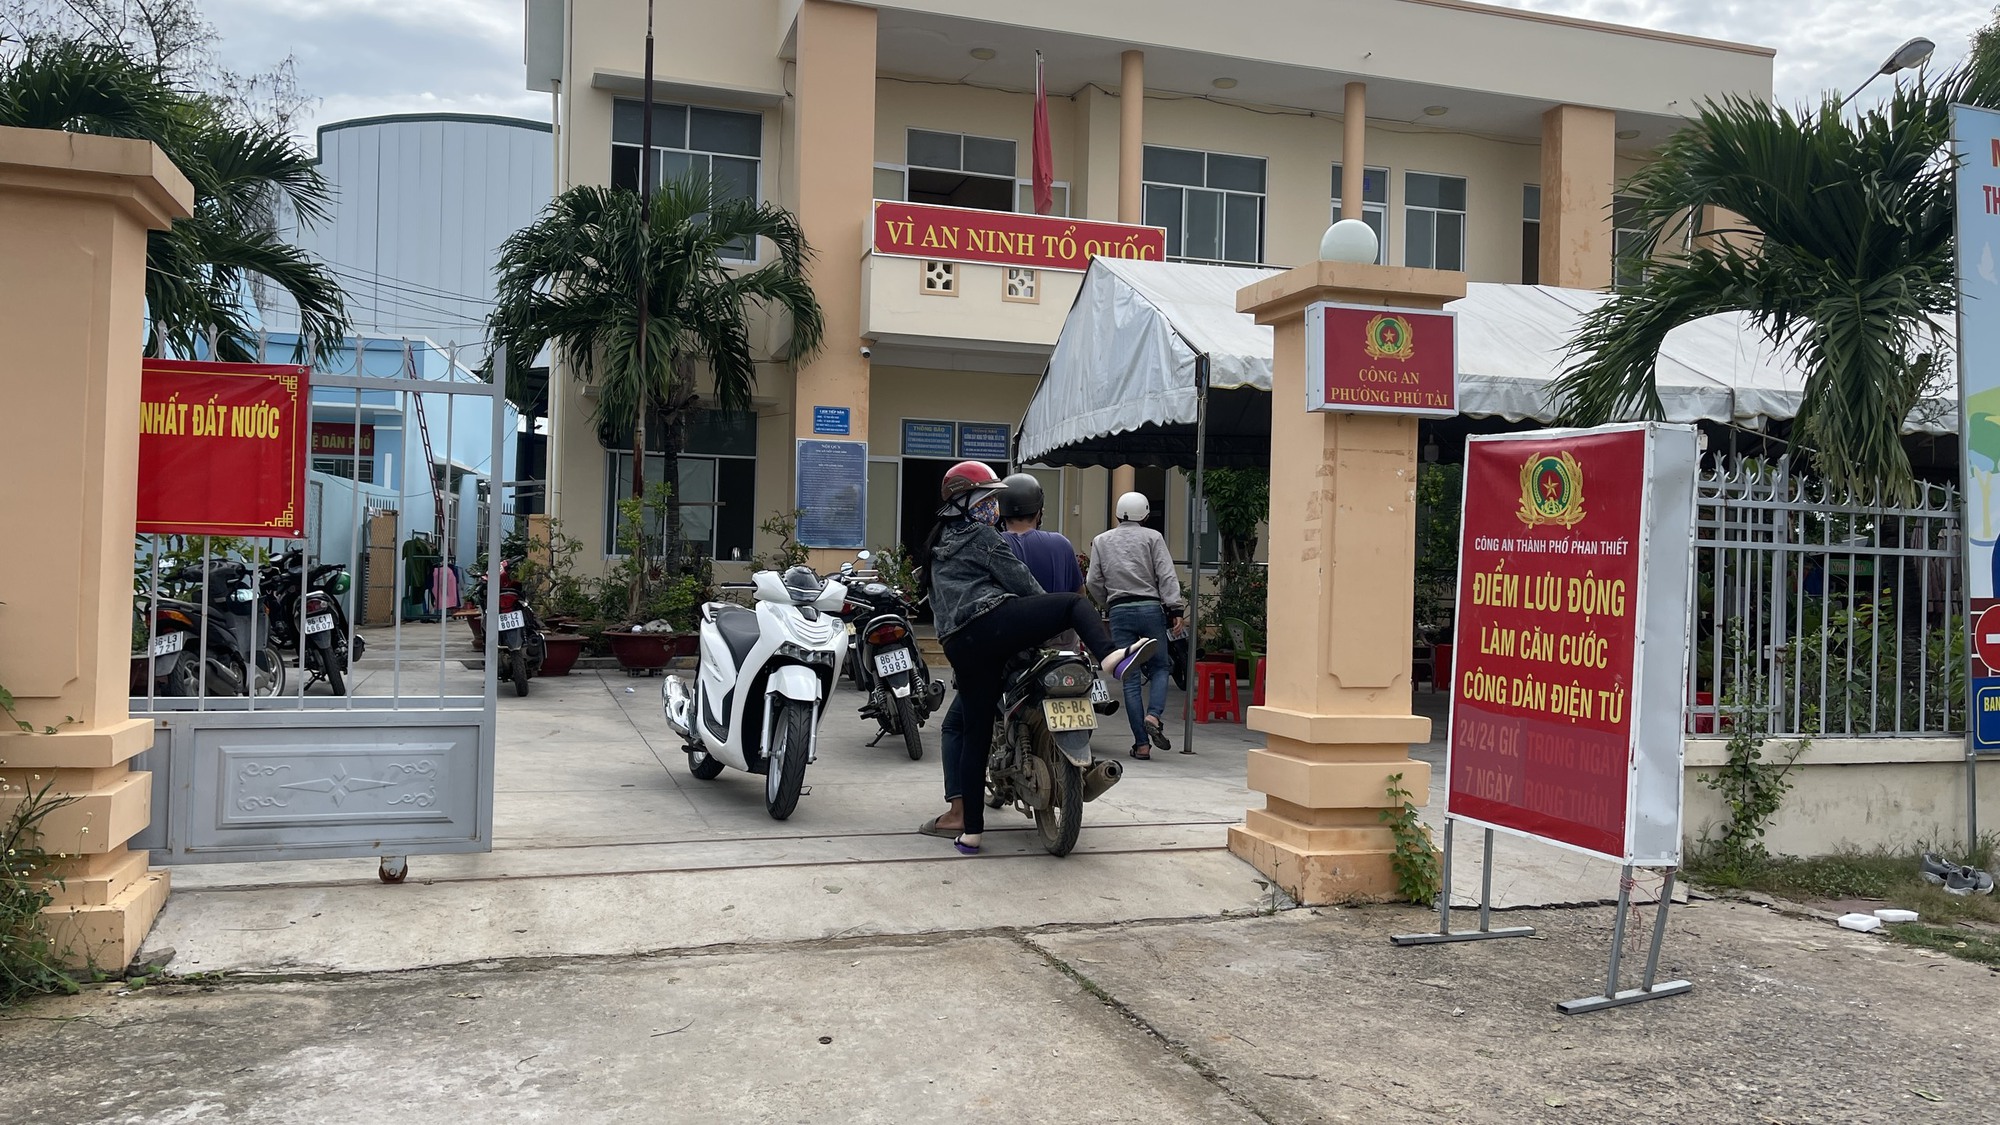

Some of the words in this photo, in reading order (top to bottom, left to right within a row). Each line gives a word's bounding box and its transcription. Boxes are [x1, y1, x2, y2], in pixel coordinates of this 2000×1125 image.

[885, 215, 915, 246] VÌ
[921, 224, 960, 250] AN
[966, 228, 1036, 257] NINH
[1042, 225, 1077, 260] TỔ
[1359, 365, 1398, 384] CÔNG
[1400, 371, 1420, 385] AN
[1331, 385, 1390, 403] PHƯỜNG
[1394, 388, 1422, 405] PHÚ
[1425, 389, 1449, 407] TÀI
[140, 391, 188, 436] NHẤT
[192, 393, 227, 437] ĐẤT
[231, 399, 280, 440] NƯỚC
[321, 433, 346, 449] DÂN
[348, 432, 371, 450] PỐ
[1475, 535, 1500, 552] CÔNG
[1501, 538, 1514, 552] AN
[1516, 536, 1546, 553] THÀNH
[1549, 535, 1570, 554] PHỐ
[1571, 540, 1598, 555] PHAN
[1600, 536, 1629, 556] THIẾT
[1472, 557, 1519, 609] ĐIỂM
[1523, 571, 1562, 612] LƯU
[1567, 569, 1626, 622] ĐỘNG
[880, 650, 905, 665] 86-L3
[1481, 621, 1516, 657] LÀM
[1520, 625, 1555, 662] CĂN
[1559, 630, 1609, 669] CƯỚC
[882, 659, 908, 674] 3983
[1051, 700, 1086, 715] 86-B4
[1463, 666, 1508, 705] CÔNG
[1511, 673, 1547, 711] DÂN
[1550, 679, 1593, 723] ĐIỆN
[1598, 682, 1625, 724] TỬ
[1459, 719, 1495, 752] 24/24
[1465, 766, 1473, 793] 7
[1476, 765, 1514, 802] NGÀY
